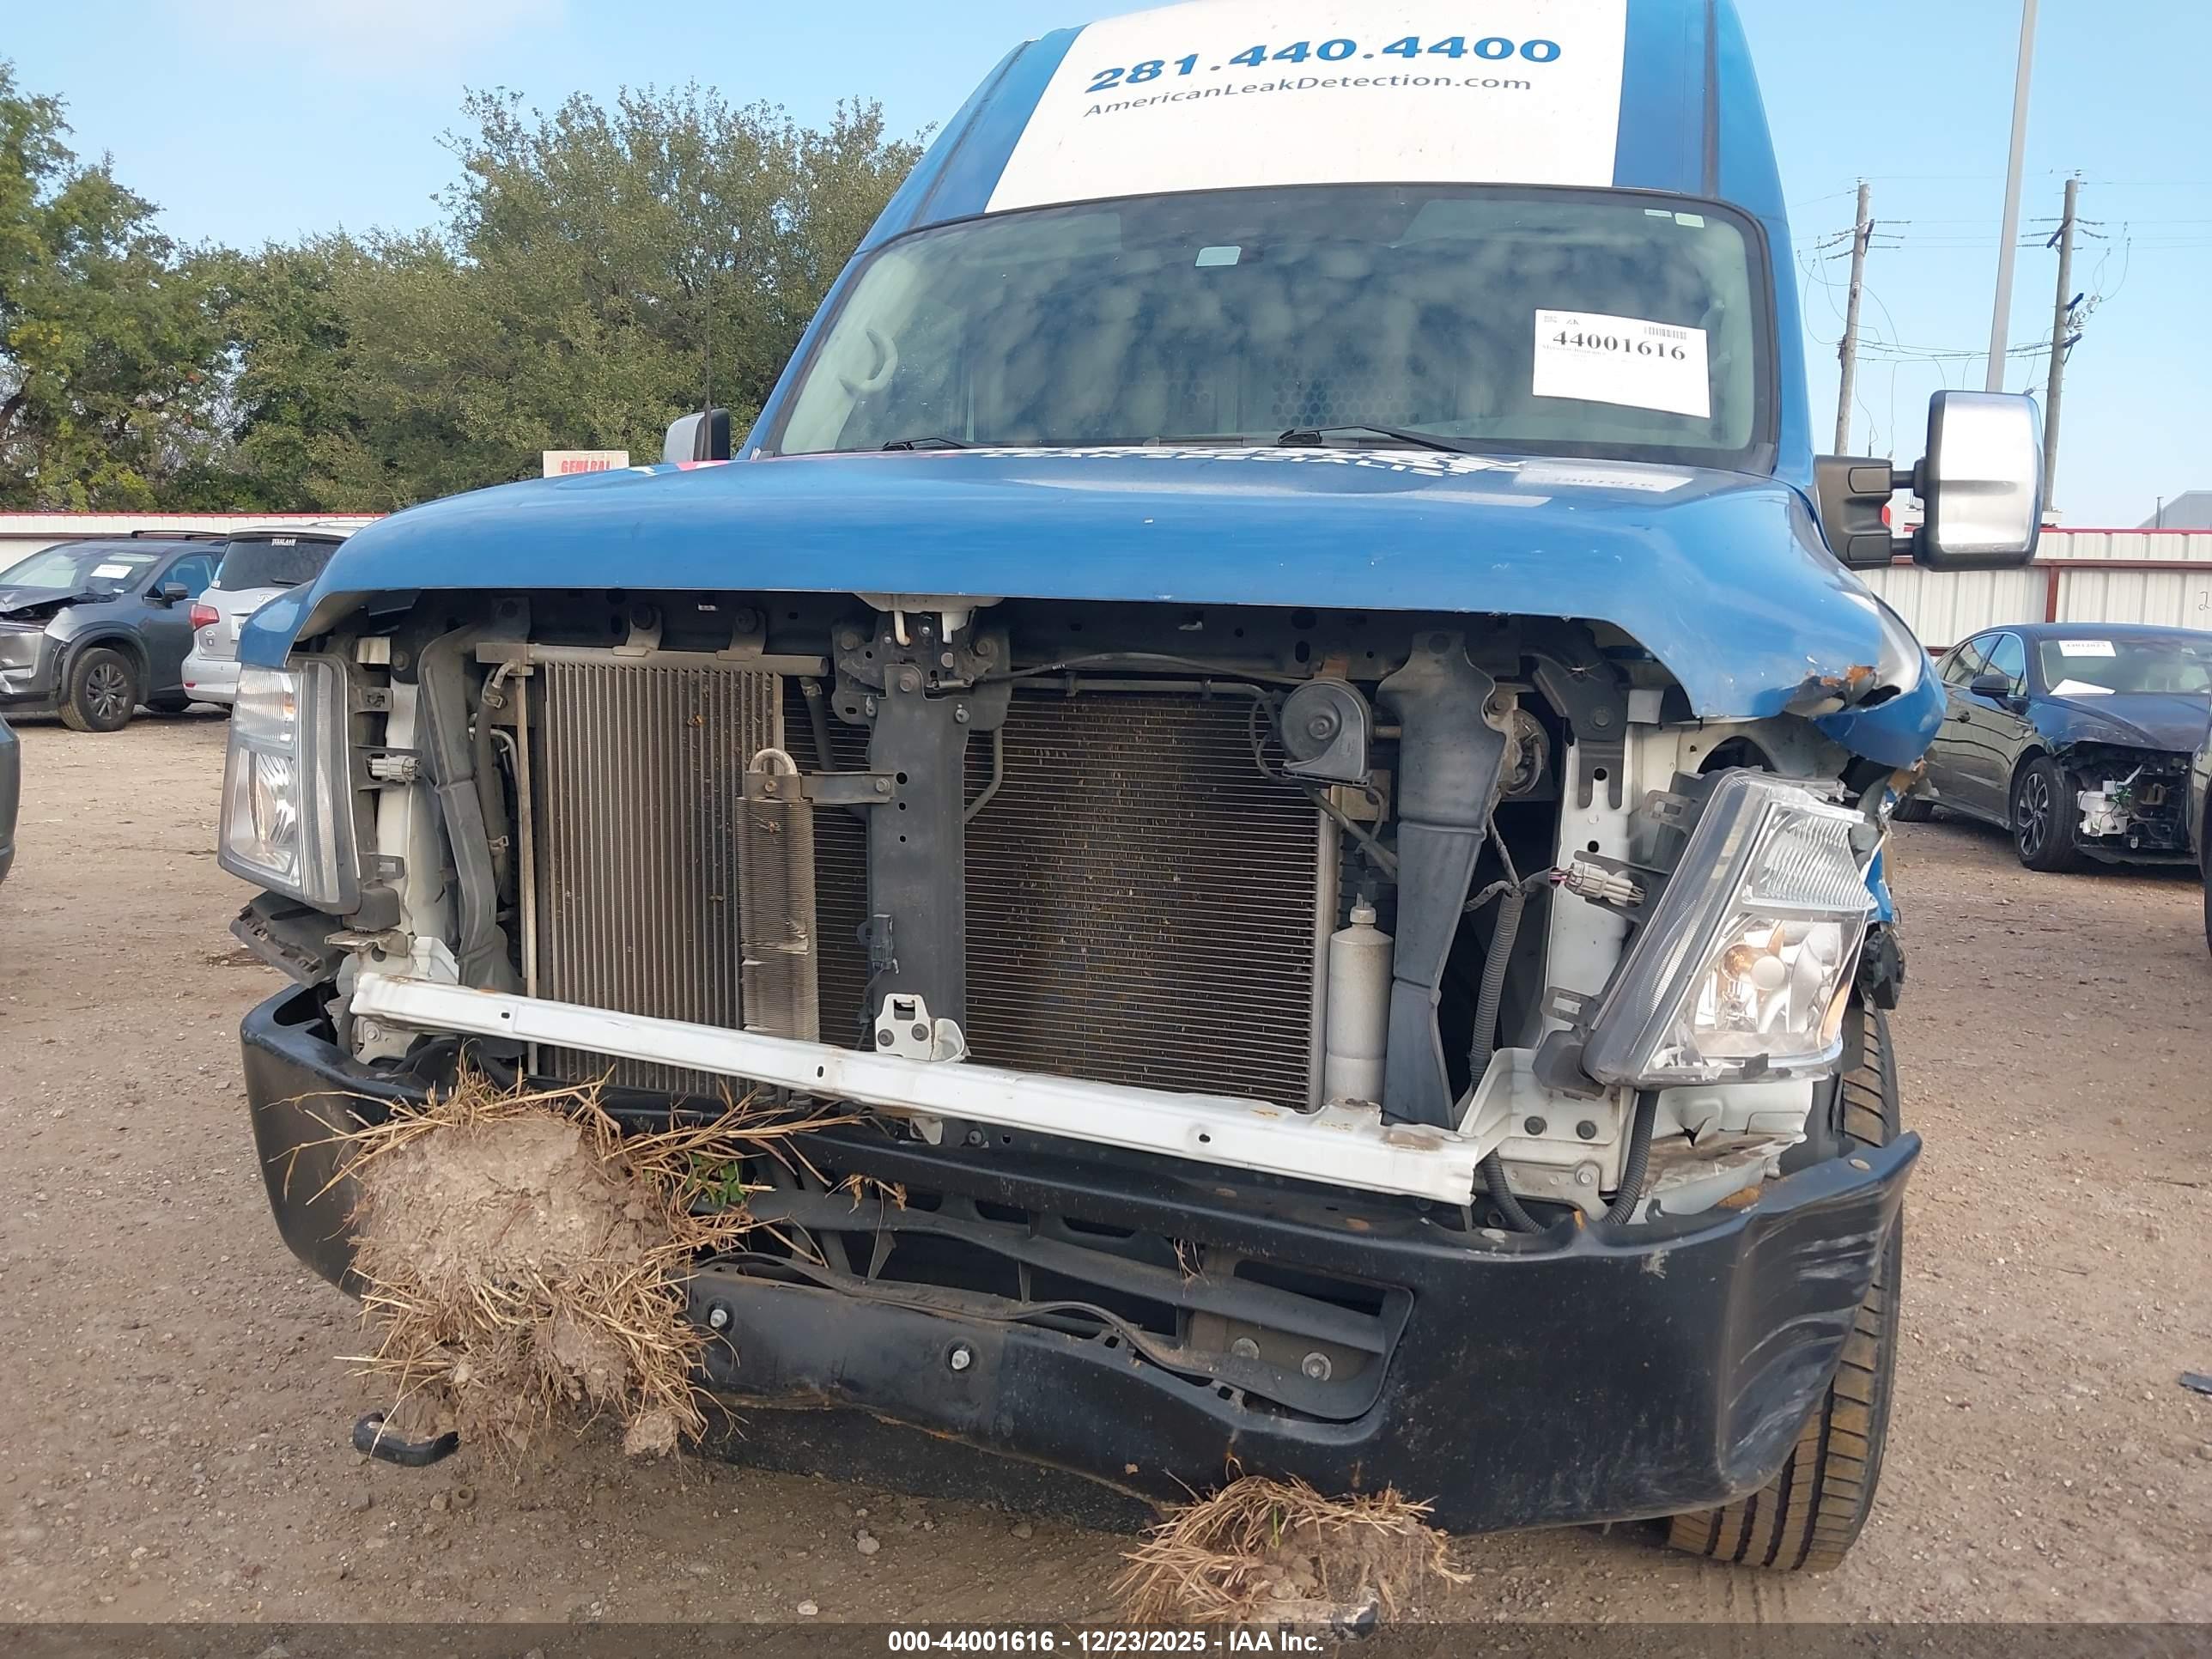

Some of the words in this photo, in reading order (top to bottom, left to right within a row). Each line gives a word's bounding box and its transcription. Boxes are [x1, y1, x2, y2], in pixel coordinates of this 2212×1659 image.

[1085, 36, 1561, 94] 281.440.4400
[1083, 74, 1531, 118] AmericanLeakDetection.com
[1553, 331, 1686, 361] 44001616
